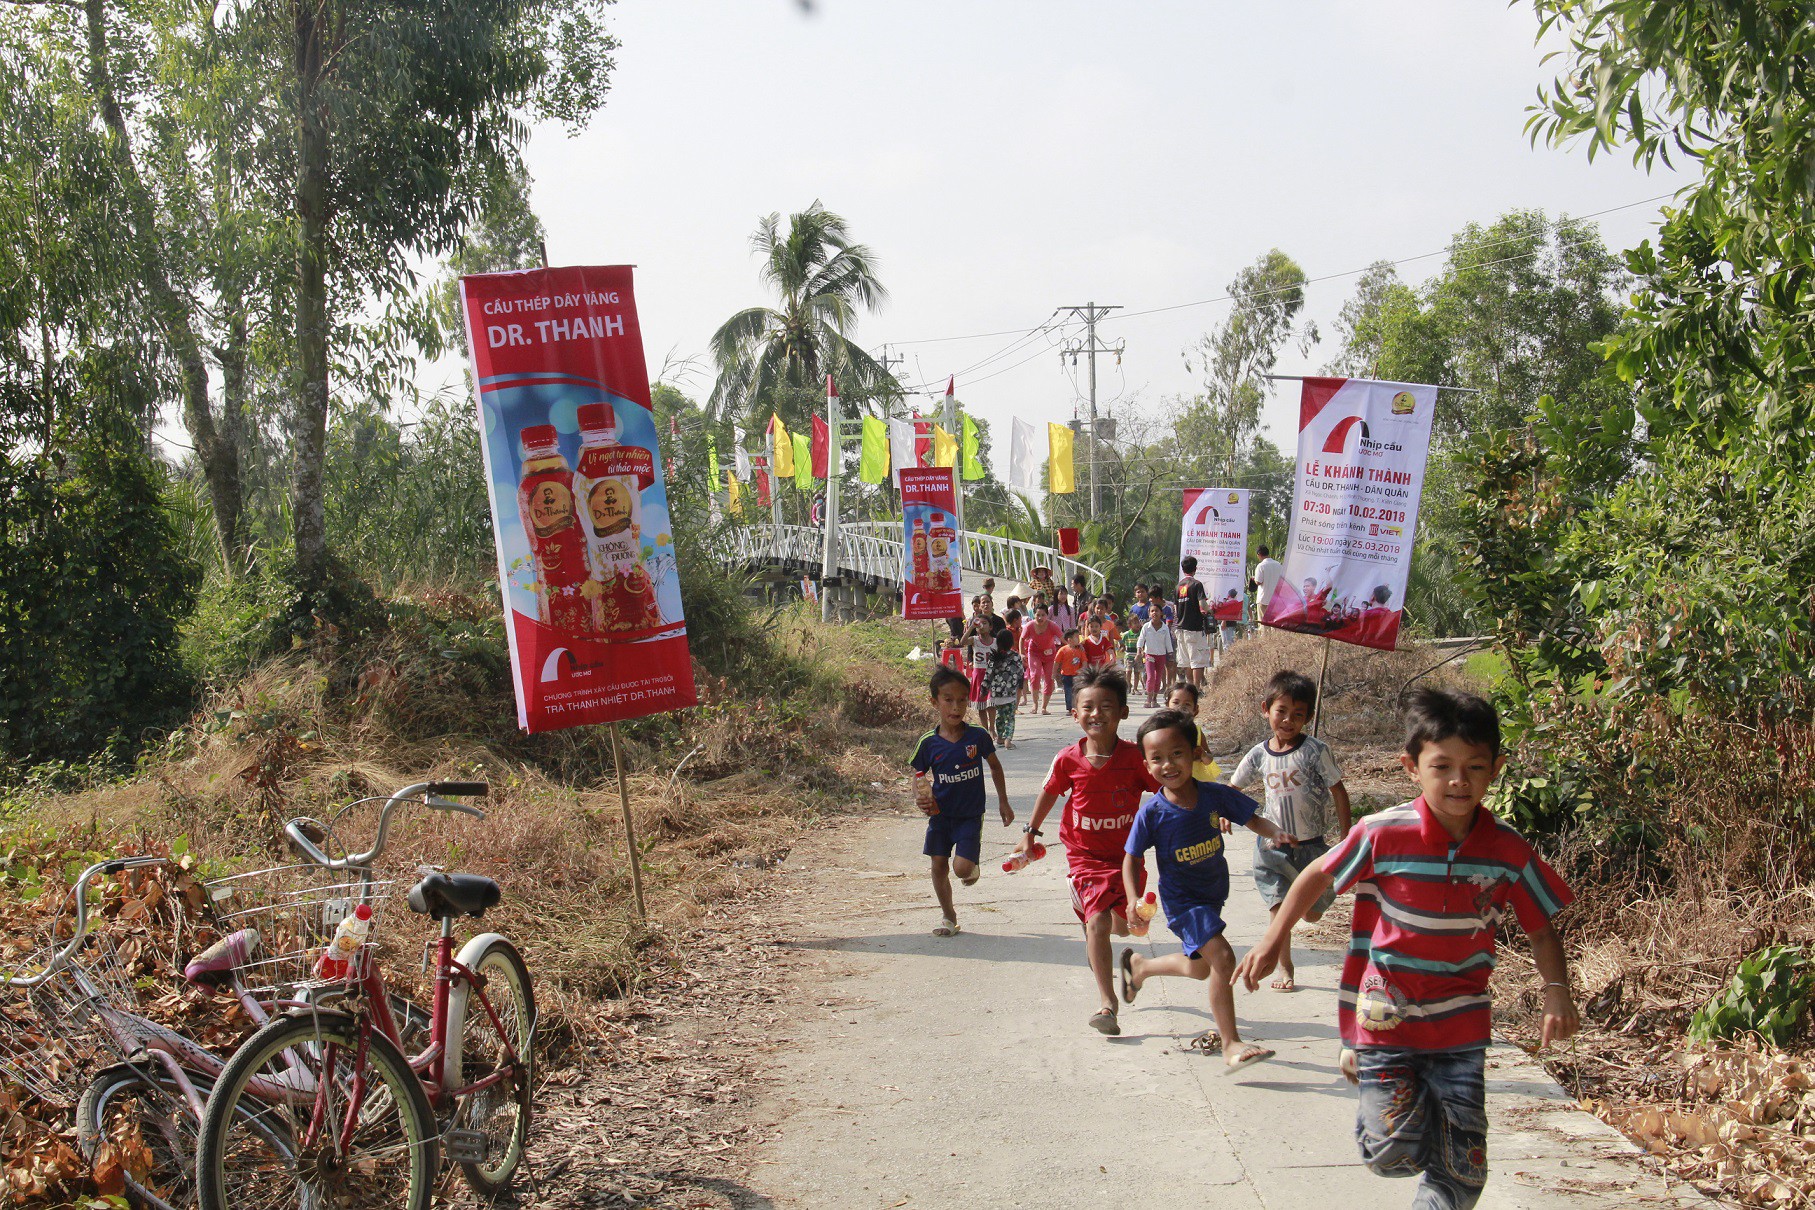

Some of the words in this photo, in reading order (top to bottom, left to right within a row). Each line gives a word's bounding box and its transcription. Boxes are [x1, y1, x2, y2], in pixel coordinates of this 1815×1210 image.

[514, 295, 551, 312] THÉP
[553, 292, 580, 308] DÂY
[583, 291, 619, 306] VĂNG
[487, 323, 532, 348] DR.
[534, 314, 624, 343] THANH
[626, 449, 650, 460] nhiên
[1360, 439, 1382, 451] Nhịp
[1306, 460, 1319, 477] LỄ
[1324, 464, 1364, 480] KHÁNH
[1369, 468, 1412, 486] THÀNH
[905, 484, 919, 493] DR.
[920, 483, 949, 492] THANH
[1365, 484, 1383, 495] DÂN
[1303, 500, 1331, 515] 07:30
[1349, 504, 1405, 523] 10.02.2018
[1301, 517, 1316, 527] Phát
[1318, 521, 1335, 530] sóng
[1349, 522, 1366, 532] kênh
[1312, 535, 1334, 545] 19:00
[1335, 539, 1351, 549] ngày
[1352, 540, 1400, 554] 25.03.2018
[545, 702, 565, 715] TRÀ
[566, 698, 599, 712] THANH
[600, 692, 628, 706] NHIỆT
[938, 766, 980, 784] Plus500
[1266, 769, 1301, 790] CK
[1175, 834, 1221, 862] GERMANY
